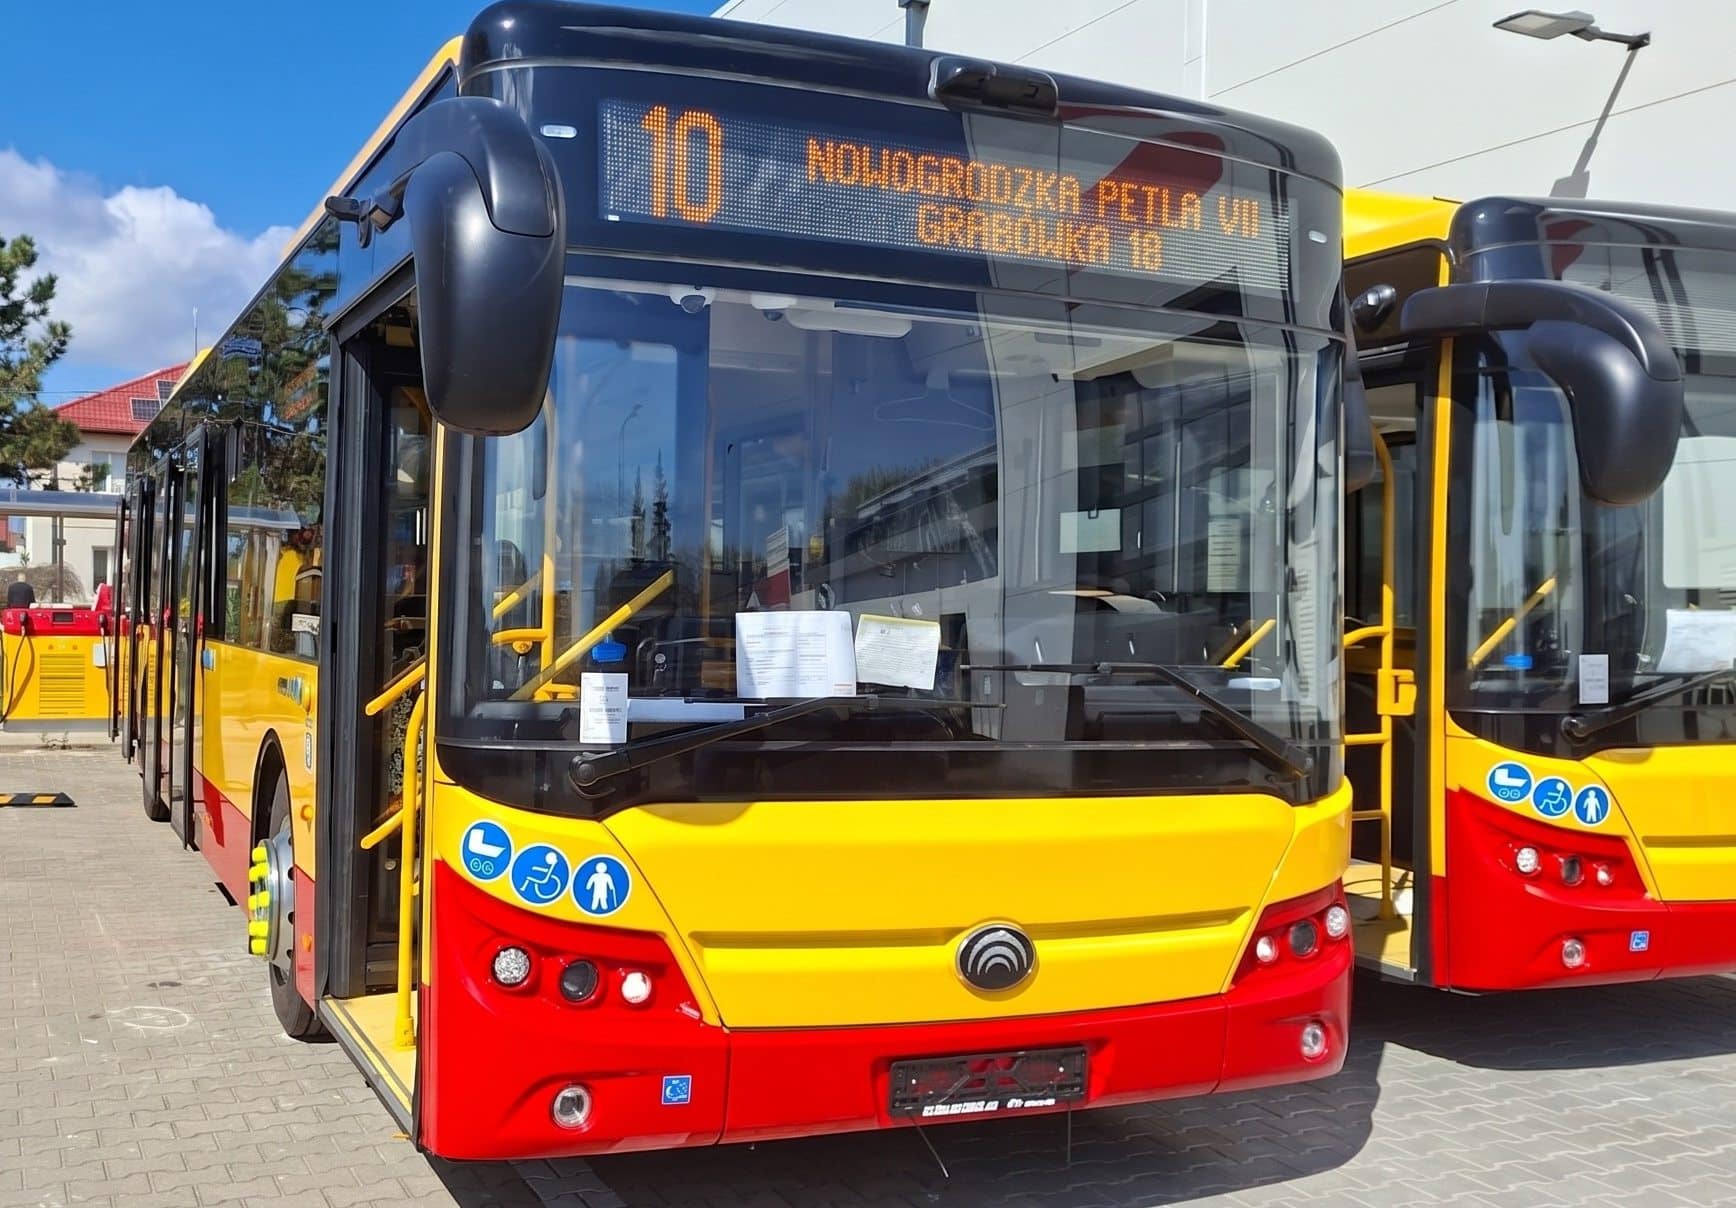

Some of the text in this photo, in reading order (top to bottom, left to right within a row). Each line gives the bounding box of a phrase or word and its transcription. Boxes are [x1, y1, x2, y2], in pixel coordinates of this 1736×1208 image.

[641, 106, 721, 222] 10
[807, 138, 1080, 215] NOWOGRODZKA
[1218, 196, 1258, 239] VII
[1129, 228, 1162, 271] 18
